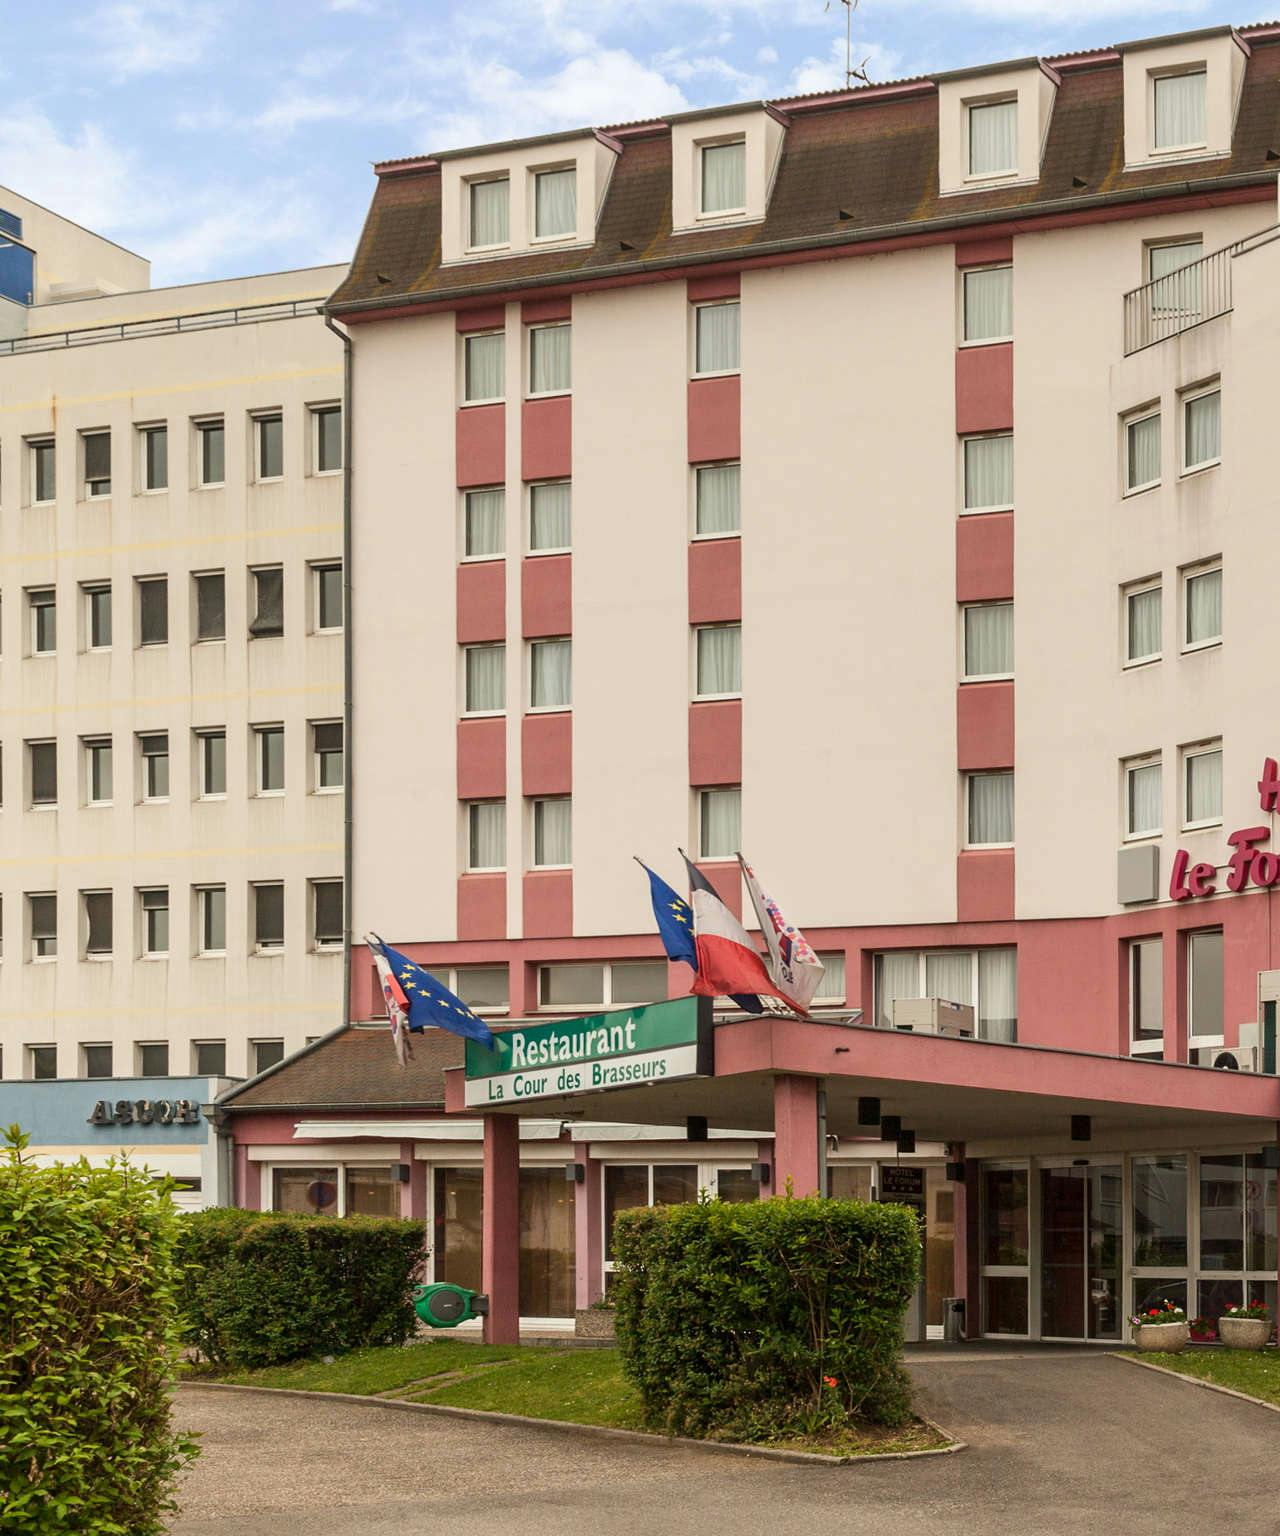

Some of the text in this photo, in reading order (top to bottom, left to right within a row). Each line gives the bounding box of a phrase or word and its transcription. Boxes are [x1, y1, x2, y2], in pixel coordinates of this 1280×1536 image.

[511, 1017, 637, 1067] Restaurant
[488, 1058, 667, 1100] La Cour des Brasseurs
